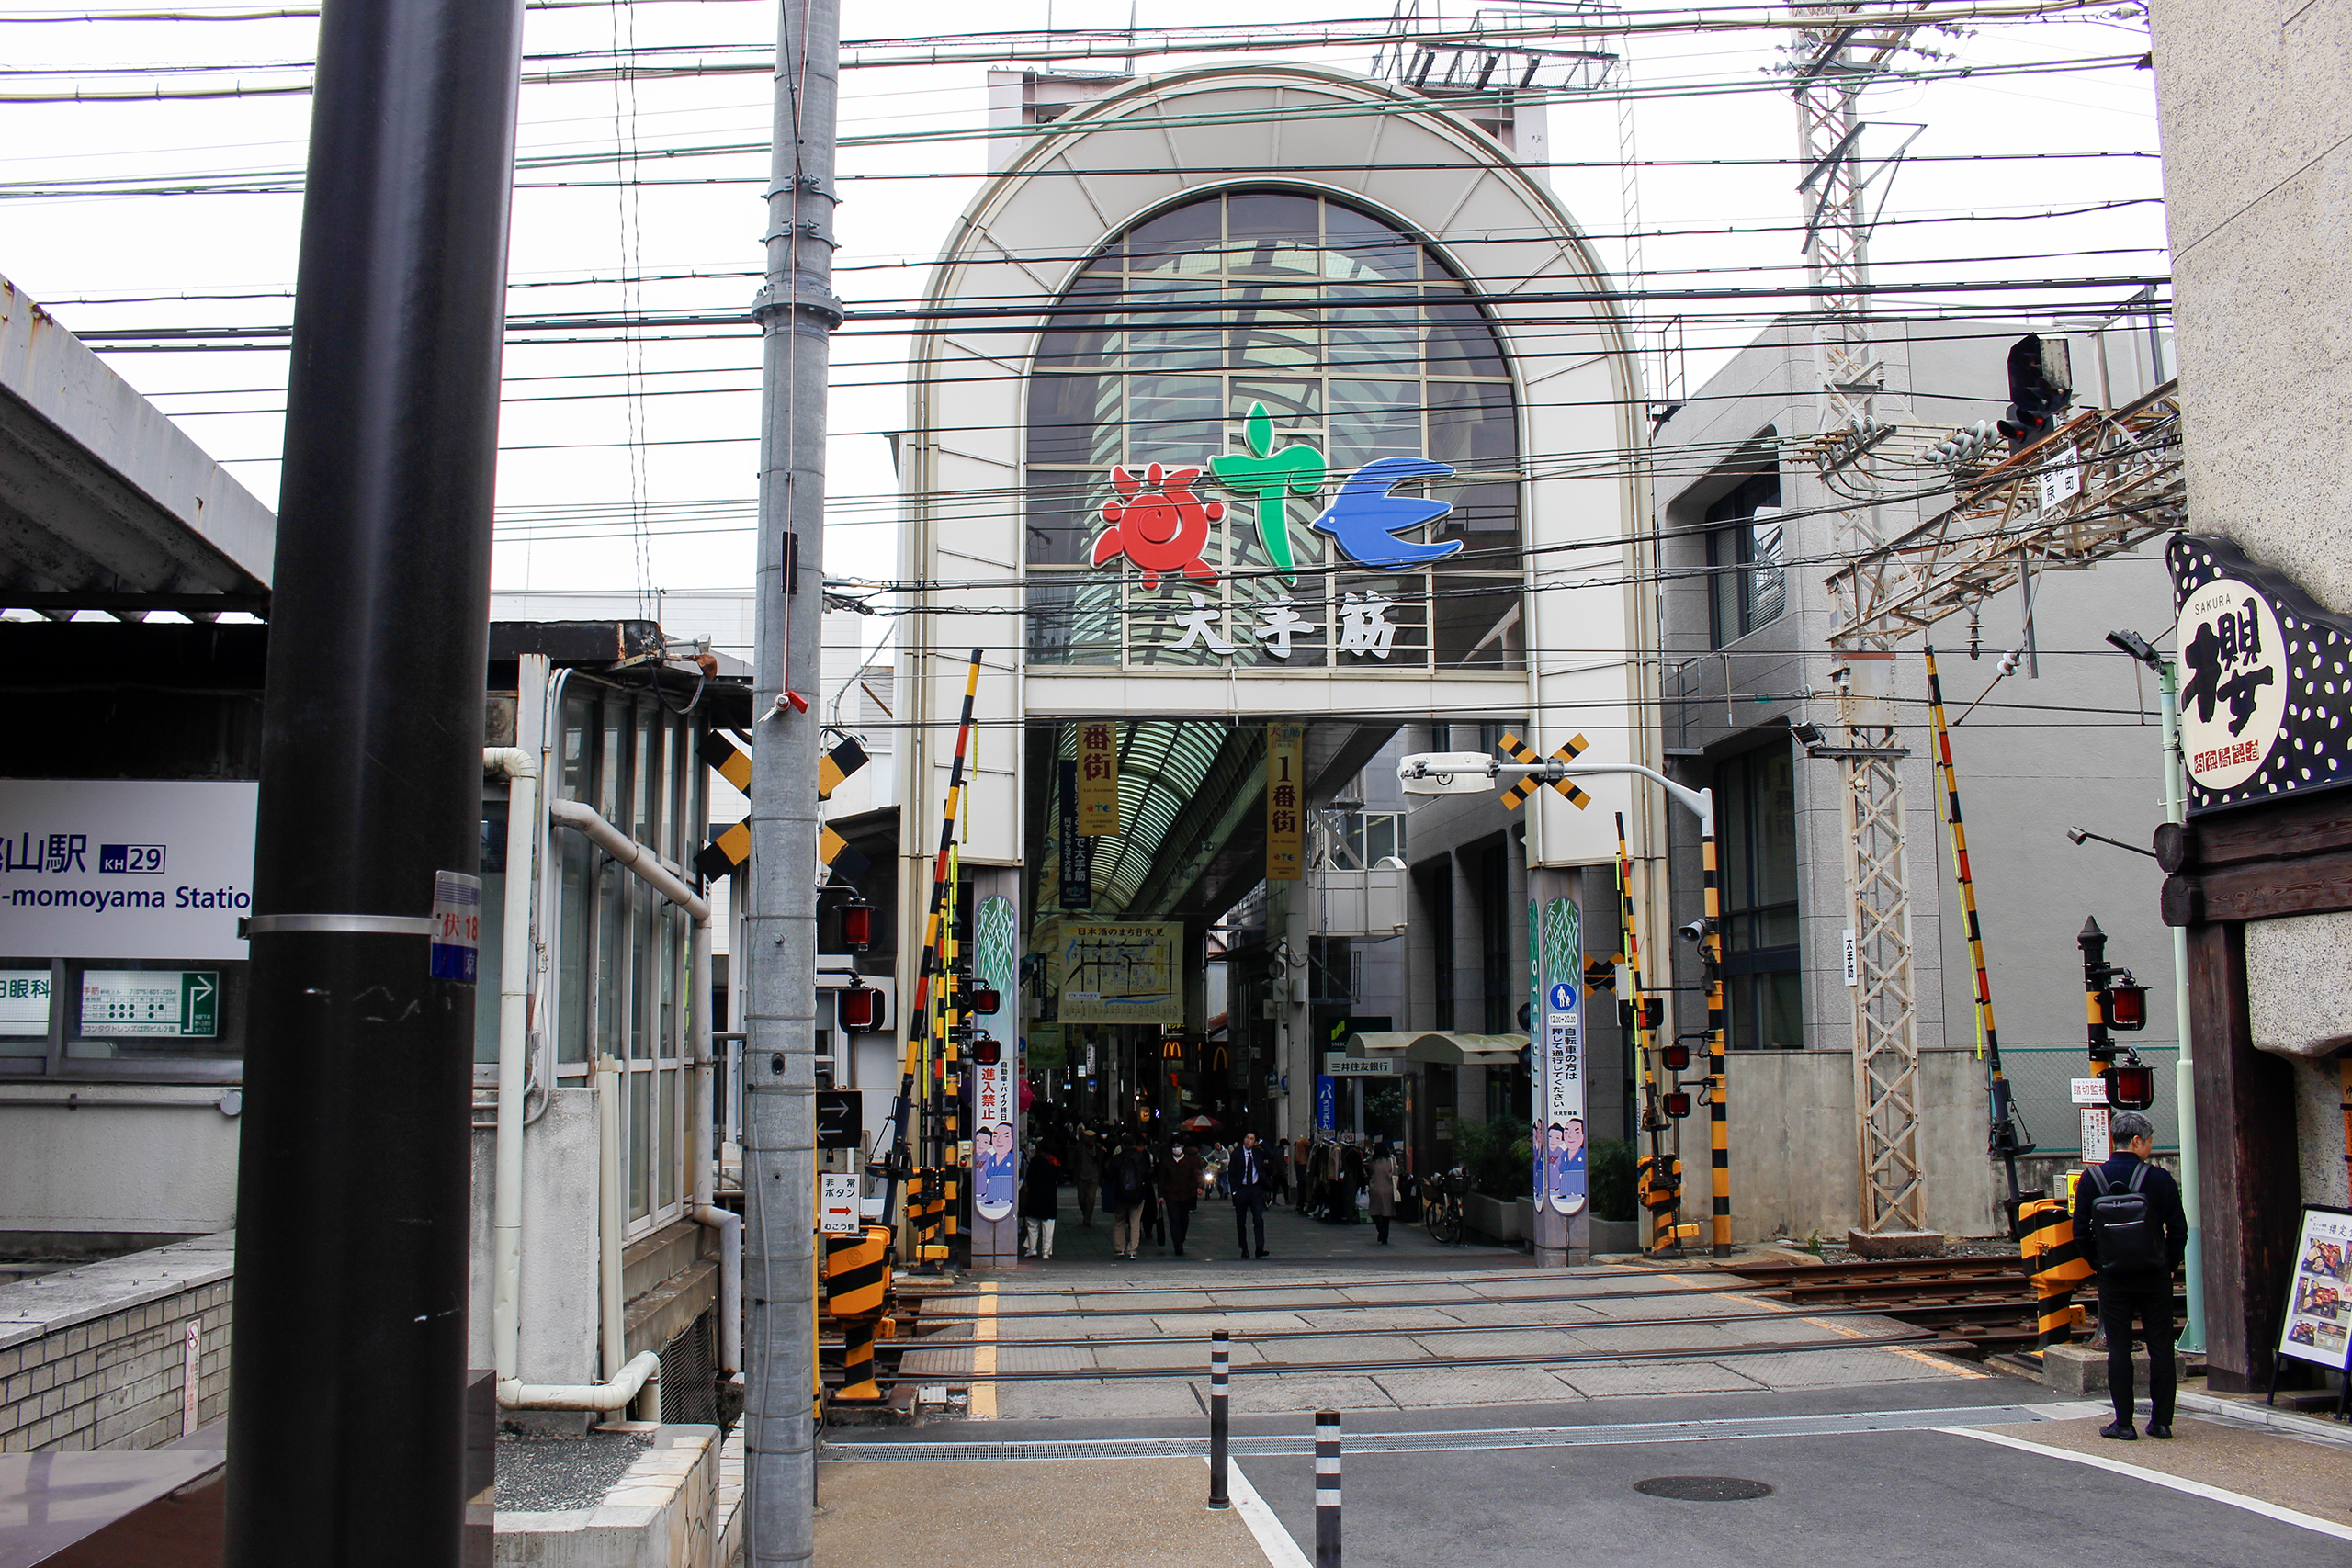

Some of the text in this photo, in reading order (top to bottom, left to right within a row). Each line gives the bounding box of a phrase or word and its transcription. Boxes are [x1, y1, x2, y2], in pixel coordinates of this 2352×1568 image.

[2194, 593, 2232, 615] SAKURA
[1165, 590, 1396, 659] 大手筋
[1272, 756, 1296, 834] 1番街
[0, 832, 87, 873] 山駅
[0, 886, 166, 912] -momoyama
[1331, 1062, 1388, 1072] 三井住友銀行
[1552, 1028, 1565, 1108] 押して通行してください
[1565, 1027, 1577, 1080] 自転車の方は
[981, 1068, 996, 1121] 進入禁止
[825, 1189, 855, 1198] ボタン
[826, 1178, 856, 1188] 非常
[824, 1223, 855, 1231] むこう側
